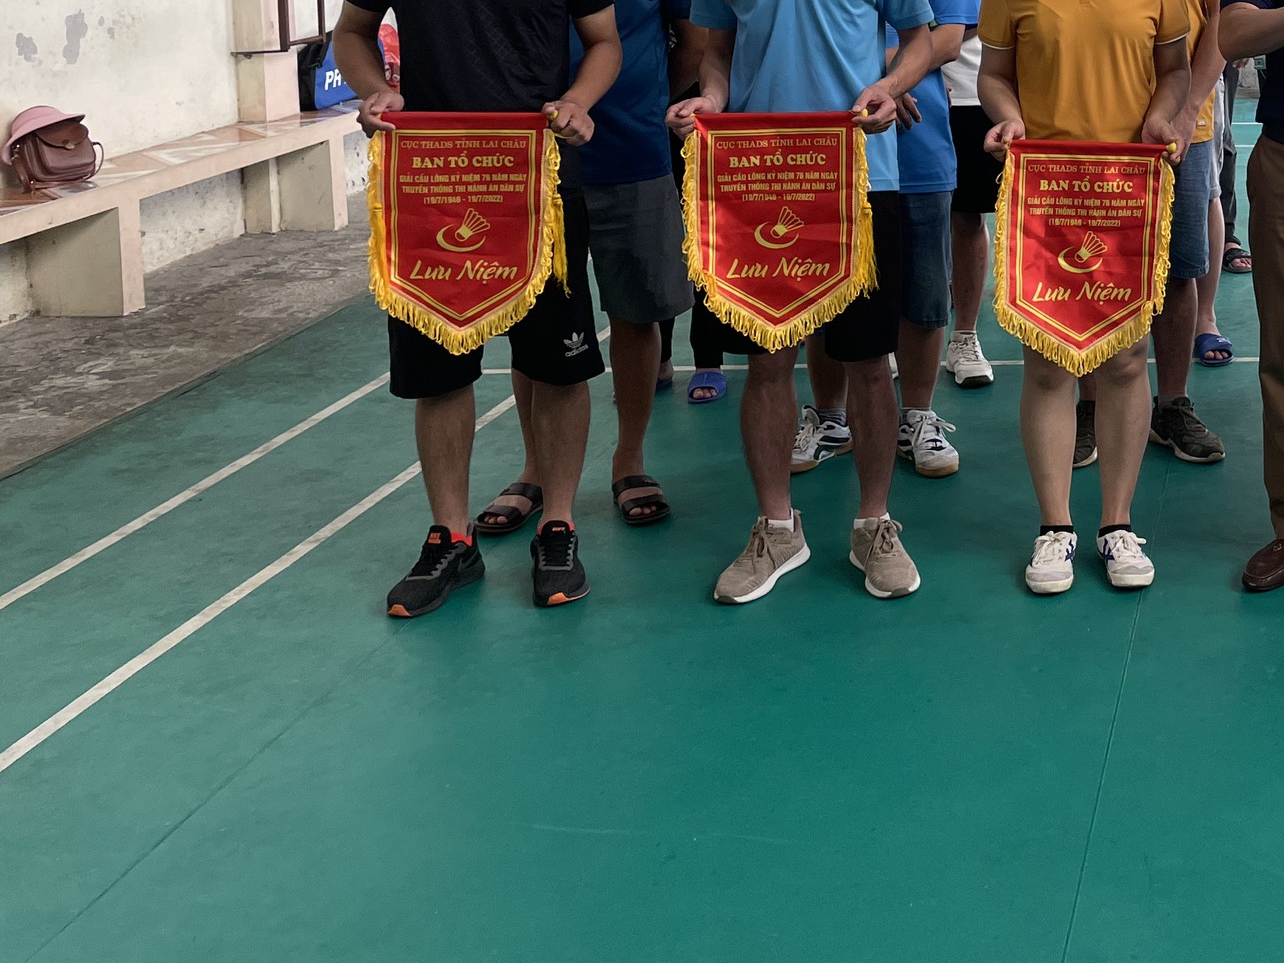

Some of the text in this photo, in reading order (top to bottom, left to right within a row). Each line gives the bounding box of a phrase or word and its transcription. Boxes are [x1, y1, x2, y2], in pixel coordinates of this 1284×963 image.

[324, 68, 347, 91] PA
[737, 140, 768, 148] THADS
[412, 151, 514, 168] BAN TỔ CHỨC
[730, 149, 826, 167] BAN TỔ CHỨC
[1040, 176, 1133, 192] BAN TỔ CHỨC
[410, 260, 518, 284] Lưu Niệm
[726, 257, 830, 281] Lưu Niệm
[1032, 281, 1131, 305] Lưu Niệm
